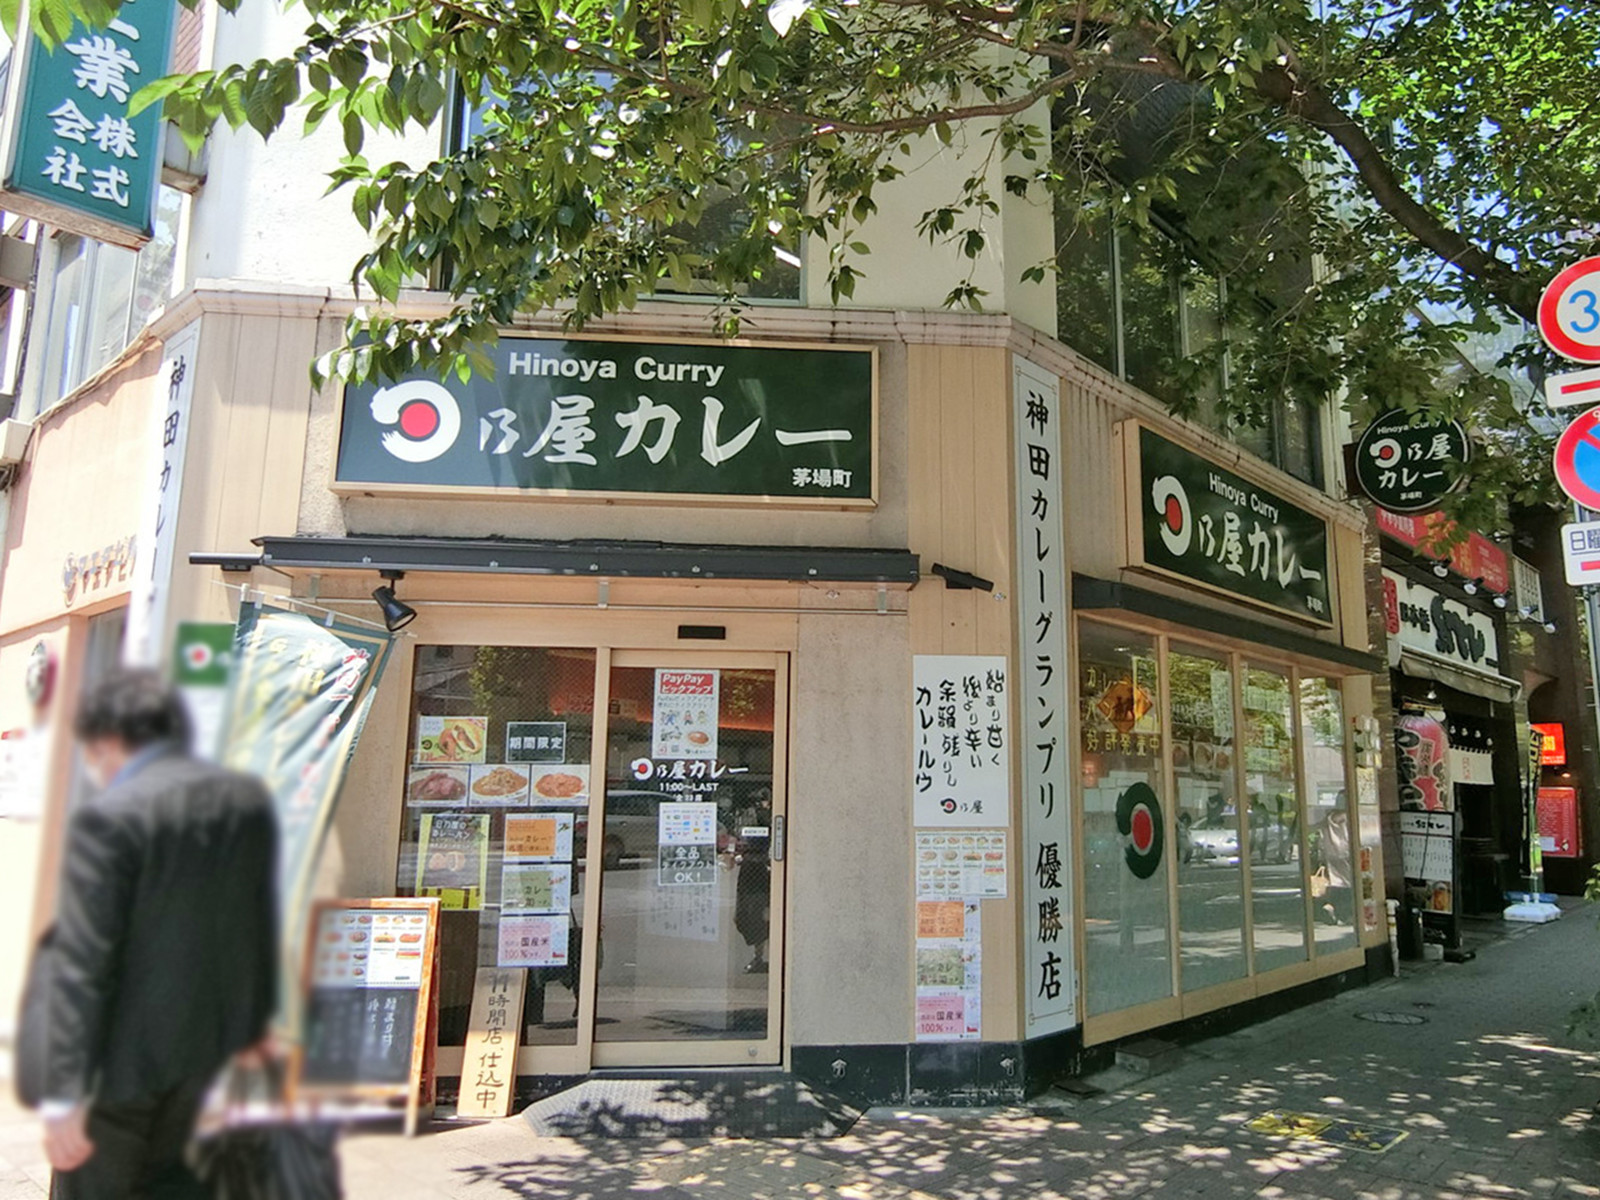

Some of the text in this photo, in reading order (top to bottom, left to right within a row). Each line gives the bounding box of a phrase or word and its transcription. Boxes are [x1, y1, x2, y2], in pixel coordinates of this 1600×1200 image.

[508, 352, 725, 385] Hinoya Curry
[1376, 423, 1409, 436] Hinoya
[792, 467, 853, 489] 茅場町
[1378, 466, 1444, 490] カレー
[1208, 472, 1279, 524] Hinoya Curry
[662, 674, 705, 685] PayPay
[962, 675, 982, 768] 後より辛い
[985, 668, 1004, 766] 始まり甘く
[509, 736, 564, 750] 期間限定
[915, 686, 936, 793] カレールウ
[675, 846, 700, 860] 全品
